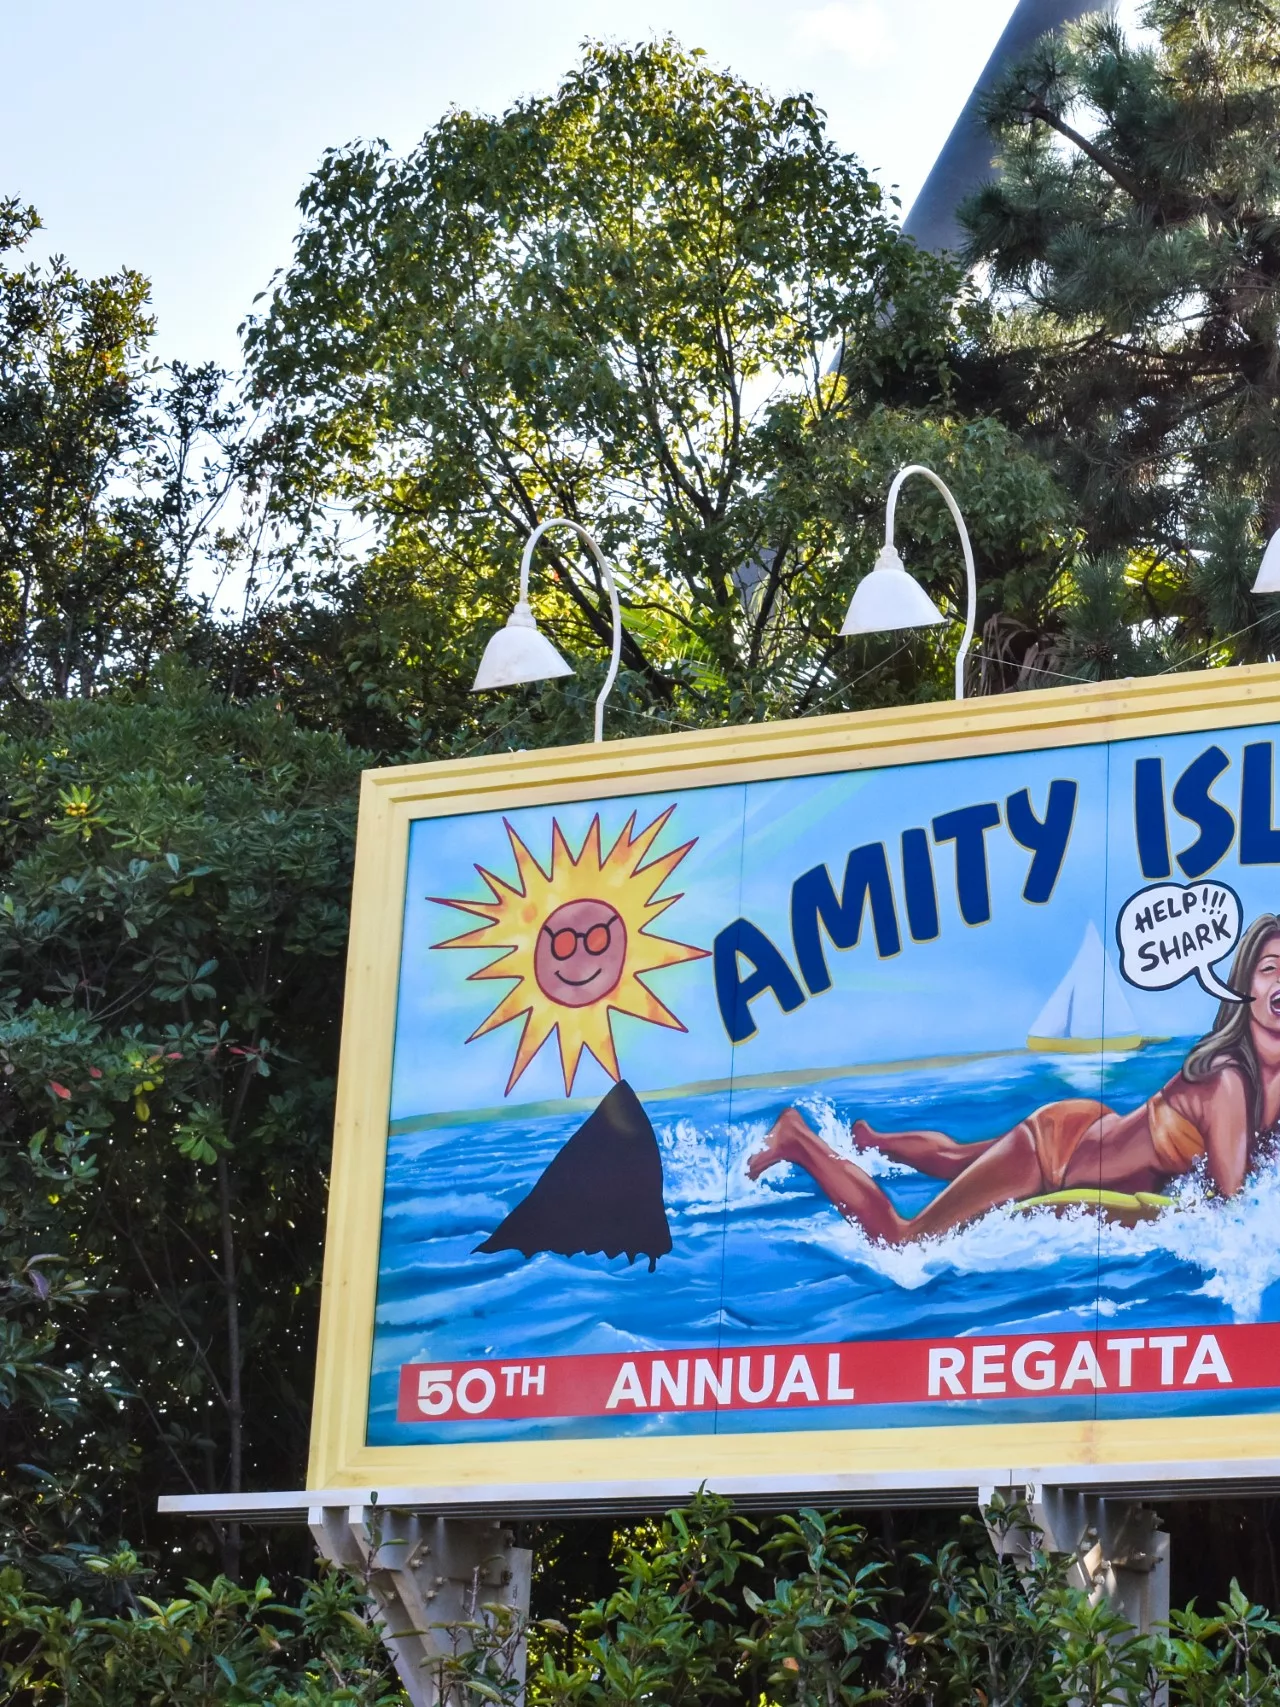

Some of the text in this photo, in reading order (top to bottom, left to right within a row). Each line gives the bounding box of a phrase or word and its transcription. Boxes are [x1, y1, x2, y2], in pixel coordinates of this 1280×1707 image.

[712, 778, 1078, 1046] AMITY
[1134, 887, 1226, 933] HELP!!!
[1137, 913, 1232, 972] SHARK
[416, 1365, 546, 1416] 50TH
[605, 1352, 855, 1410] ANNUAL
[926, 1334, 1234, 1396] REGATTA
